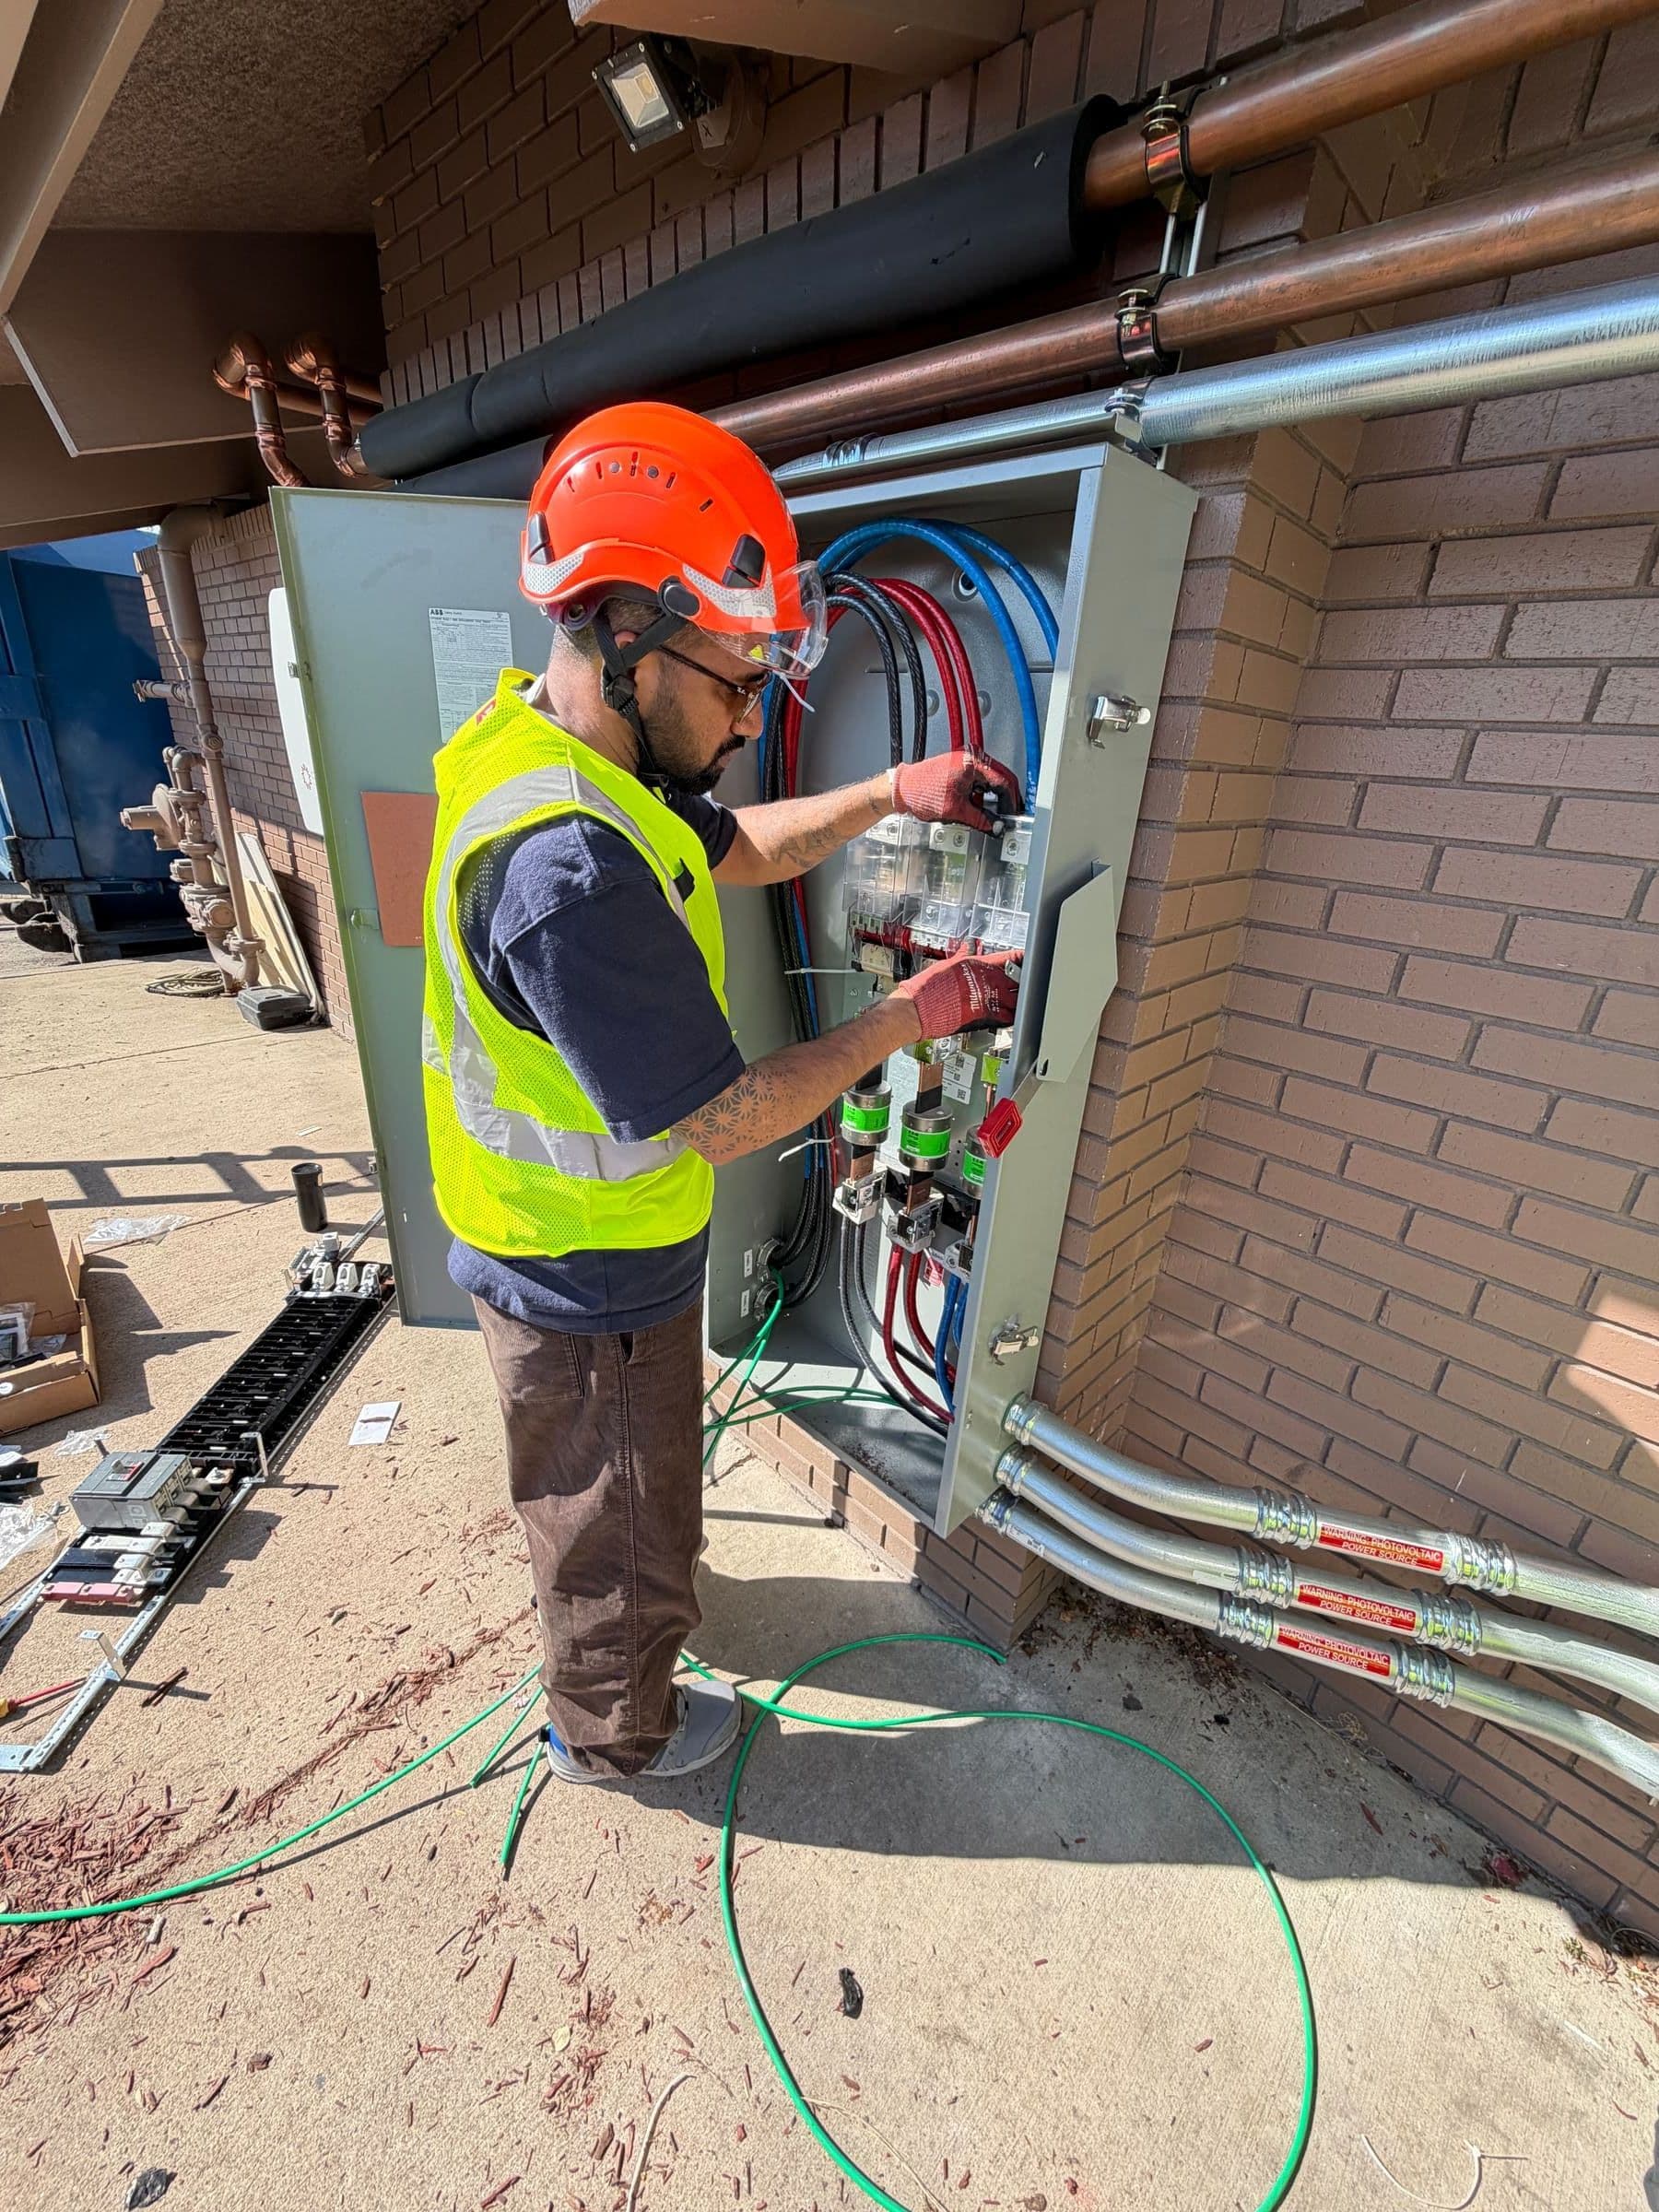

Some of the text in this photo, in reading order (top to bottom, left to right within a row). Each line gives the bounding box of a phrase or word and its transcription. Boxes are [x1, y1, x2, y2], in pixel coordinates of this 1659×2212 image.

[1341, 1541, 1418, 1565] POWER SOURCE
[1371, 1538, 1441, 1561] PHOTOVOLTAIC
[1320, 1600, 1393, 1625] POWER SOURCE
[1347, 1596, 1415, 1622] PHOTOVOLTAIC
[1298, 1642, 1369, 1670] POWER SOURCE
[1325, 1639, 1388, 1665] PHOTOVOLTAIC
